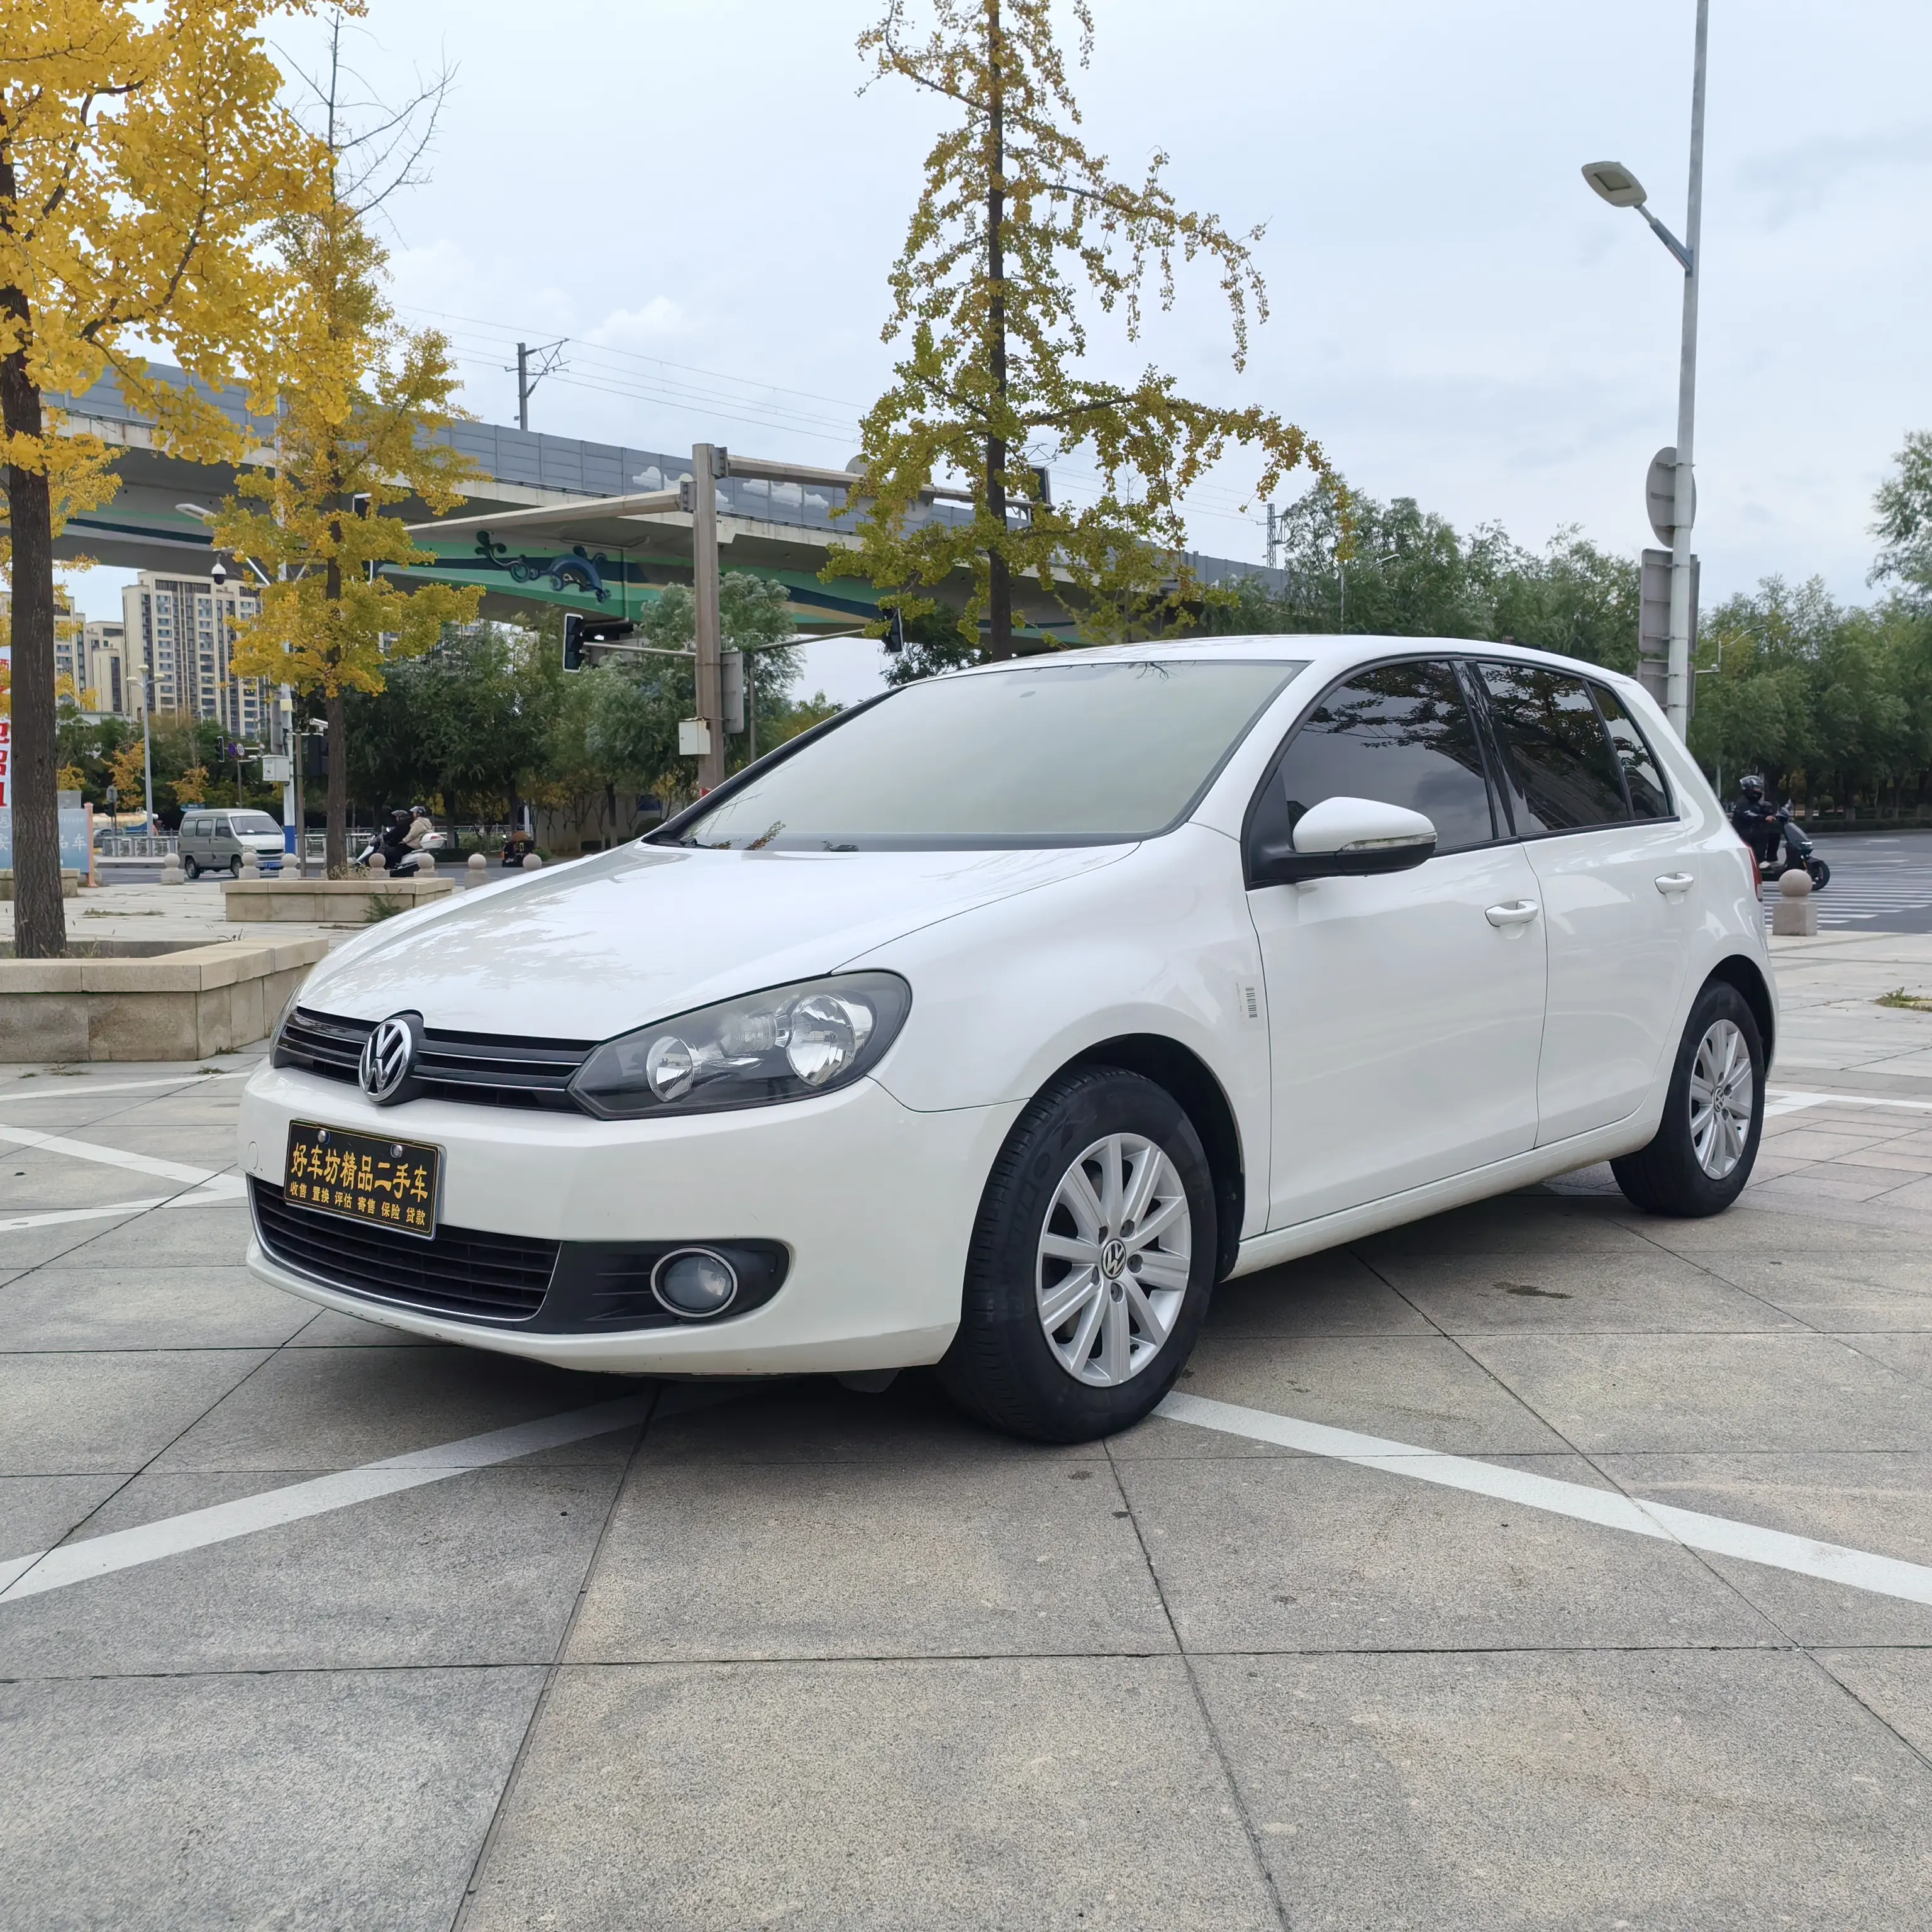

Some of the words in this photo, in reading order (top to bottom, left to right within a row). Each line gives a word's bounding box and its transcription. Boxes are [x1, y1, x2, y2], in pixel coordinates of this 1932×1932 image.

[291, 1142, 428, 1203] 好车坊精品二手车
[290, 1181, 308, 1199] 收售
[311, 1186, 330, 1204] 置换
[335, 1191, 353, 1209] 评估
[357, 1196, 376, 1214] 寄售
[381, 1201, 401, 1220] 保险
[405, 1207, 426, 1226] 贷款
